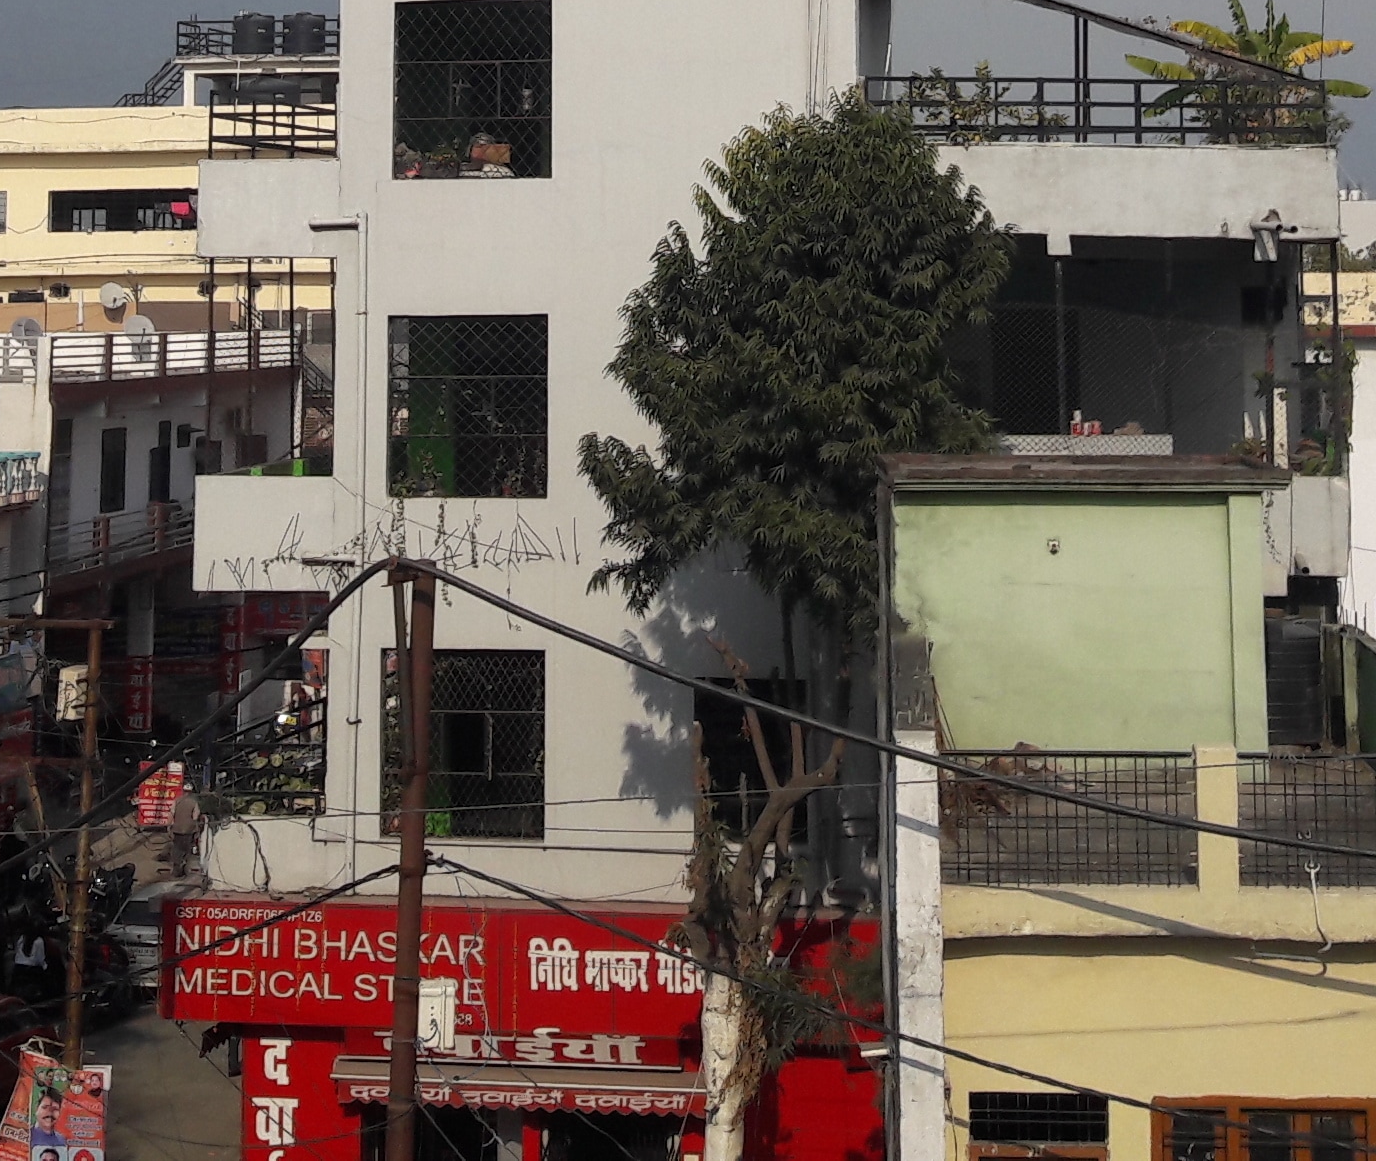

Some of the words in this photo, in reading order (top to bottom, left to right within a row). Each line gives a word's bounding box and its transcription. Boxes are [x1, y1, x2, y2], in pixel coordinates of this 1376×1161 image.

[174, 925, 281, 959] NIDHI
[294, 928, 486, 966] BHASKAR
[527, 937, 580, 991] निधि
[174, 967, 344, 1002] MEDICAL
[353, 973, 485, 1007] STE
